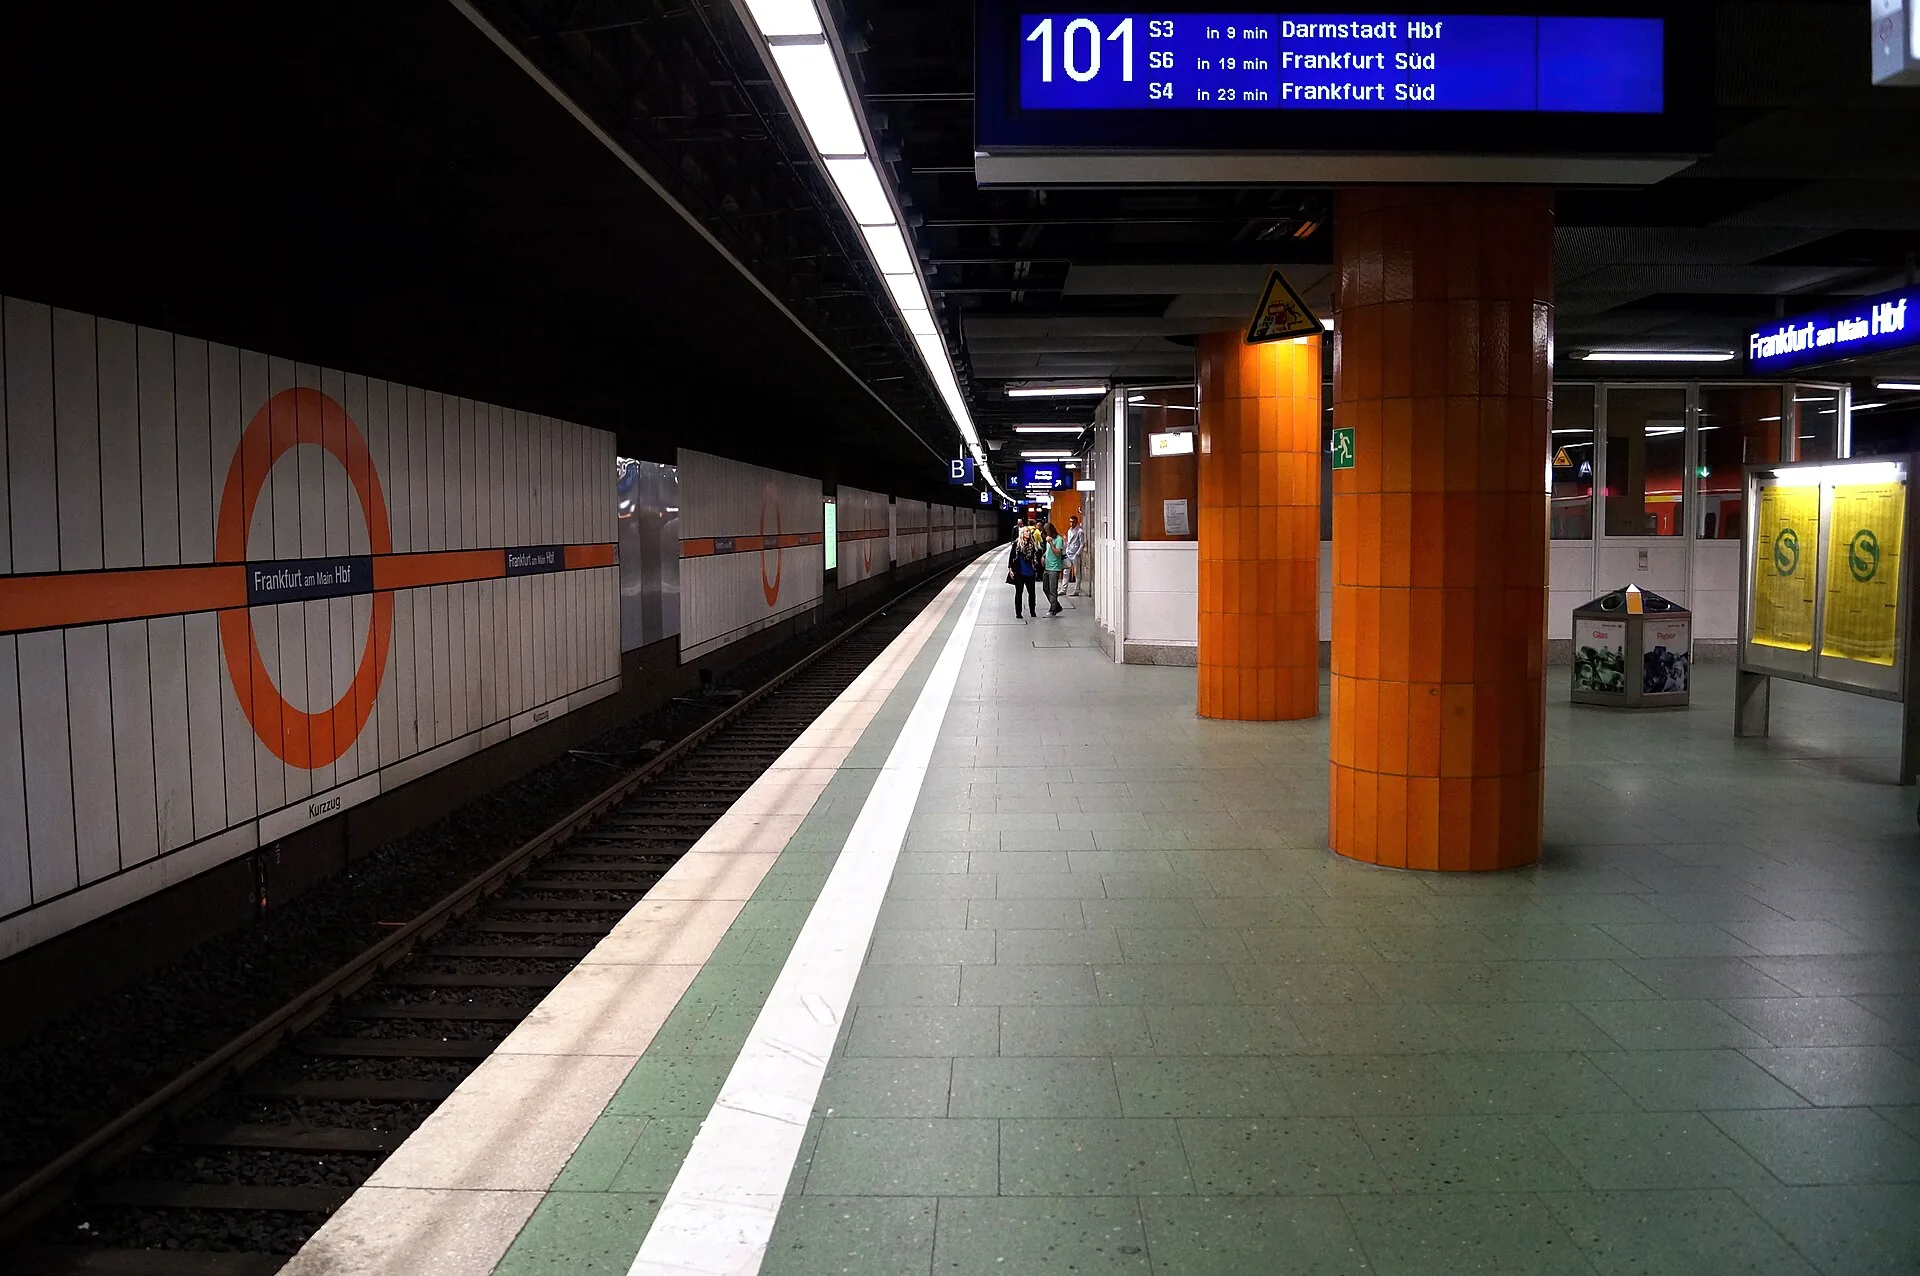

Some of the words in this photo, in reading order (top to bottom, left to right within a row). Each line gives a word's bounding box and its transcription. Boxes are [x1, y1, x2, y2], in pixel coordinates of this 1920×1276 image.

[1149, 20, 1174, 38] S3
[1206, 26, 1220, 39] in
[1226, 26, 1236, 39] 9
[1243, 26, 1268, 39] min
[1282, 20, 1397, 39] Darmstadt
[1407, 21, 1443, 39] Hbf
[1026, 18, 1133, 82] 101
[1149, 51, 1174, 69] S6
[1197, 57, 1210, 70] in
[1218, 57, 1236, 70] 19
[1243, 57, 1268, 70] min
[1282, 51, 1385, 69] Frankfurt
[1395, 52, 1435, 70] Süd
[1149, 82, 1174, 99] S4
[1197, 88, 1210, 101] in
[1217, 88, 1236, 101] 23
[1243, 88, 1268, 101] min
[1282, 82, 1385, 100] Frankfurt
[1395, 83, 1435, 101] Süd
[1749, 321, 1815, 360] Frankfurt
[1837, 317, 1869, 343] Main
[1871, 298, 1907, 336] Hbf
[951, 460, 964, 479] B
[980, 492, 989, 502] B
[508, 553, 531, 567] Frankfurt
[546, 551, 554, 564] Hbf
[254, 569, 302, 591] Frankfurt
[304, 574, 316, 587] am
[316, 571, 334, 585] Main
[334, 565, 351, 584] Hbf
[309, 796, 341, 819] Kurzzug
